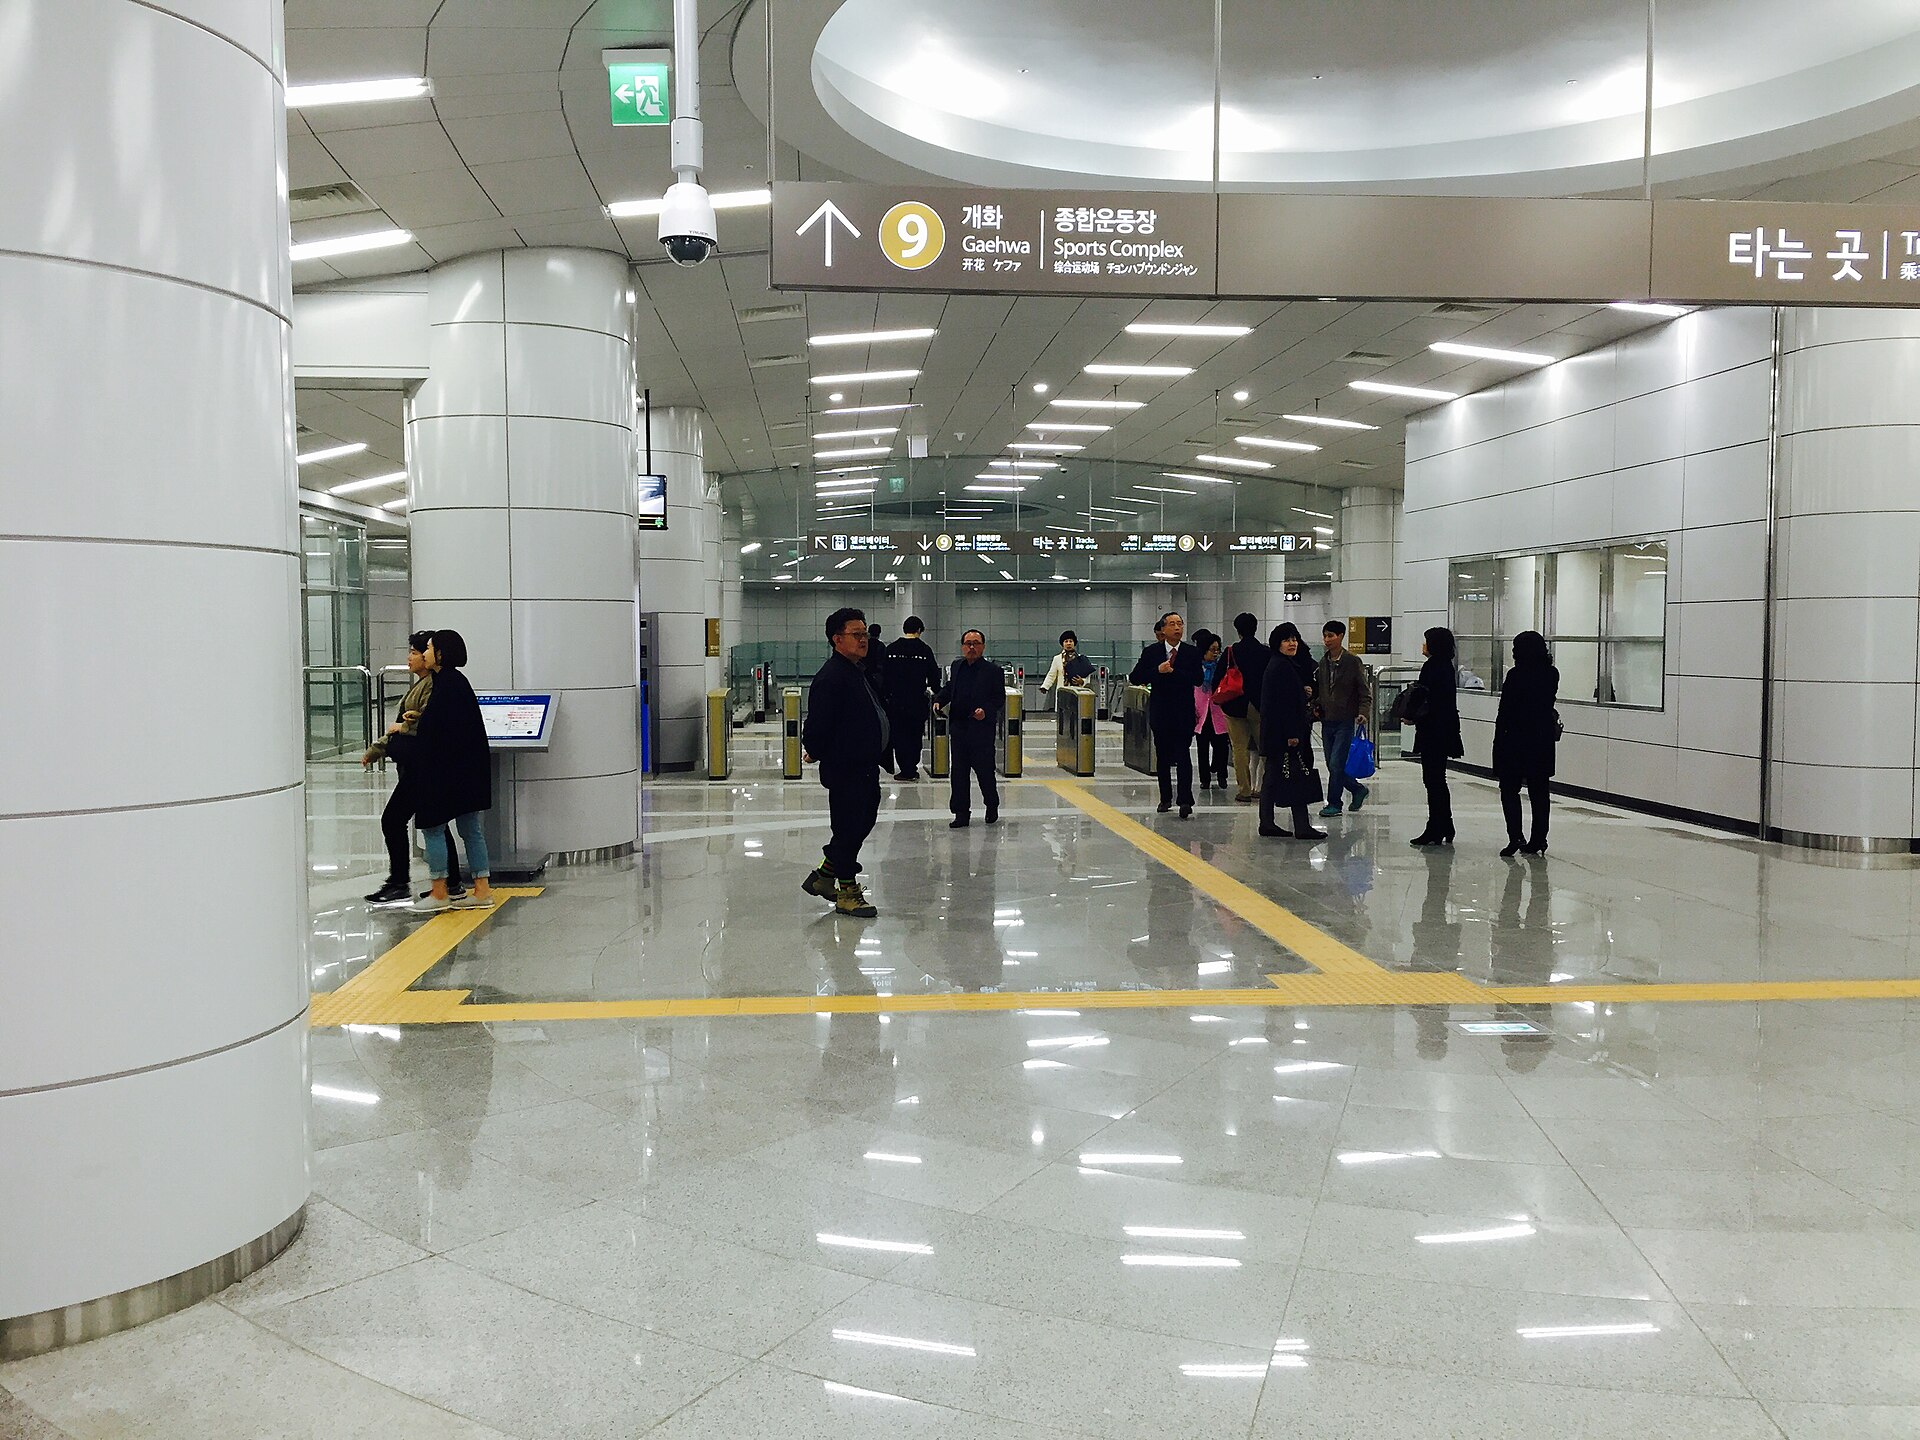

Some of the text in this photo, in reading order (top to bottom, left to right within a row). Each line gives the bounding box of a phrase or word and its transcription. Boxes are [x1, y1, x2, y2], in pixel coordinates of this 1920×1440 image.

[961, 204, 1004, 231] 개화
[1053, 207, 1158, 235] 종합운동장
[896, 213, 930, 259] 9
[962, 235, 1031, 254] Gaehwa
[1053, 237, 1184, 262] Sports Complex
[1728, 226, 1870, 281] 타는 곳
[962, 258, 1022, 272] 开花 ケファ
[1053, 259, 1100, 275] 综合运动场
[1032, 536, 1055, 550] 타는
[1056, 536, 1069, 550] 곳
